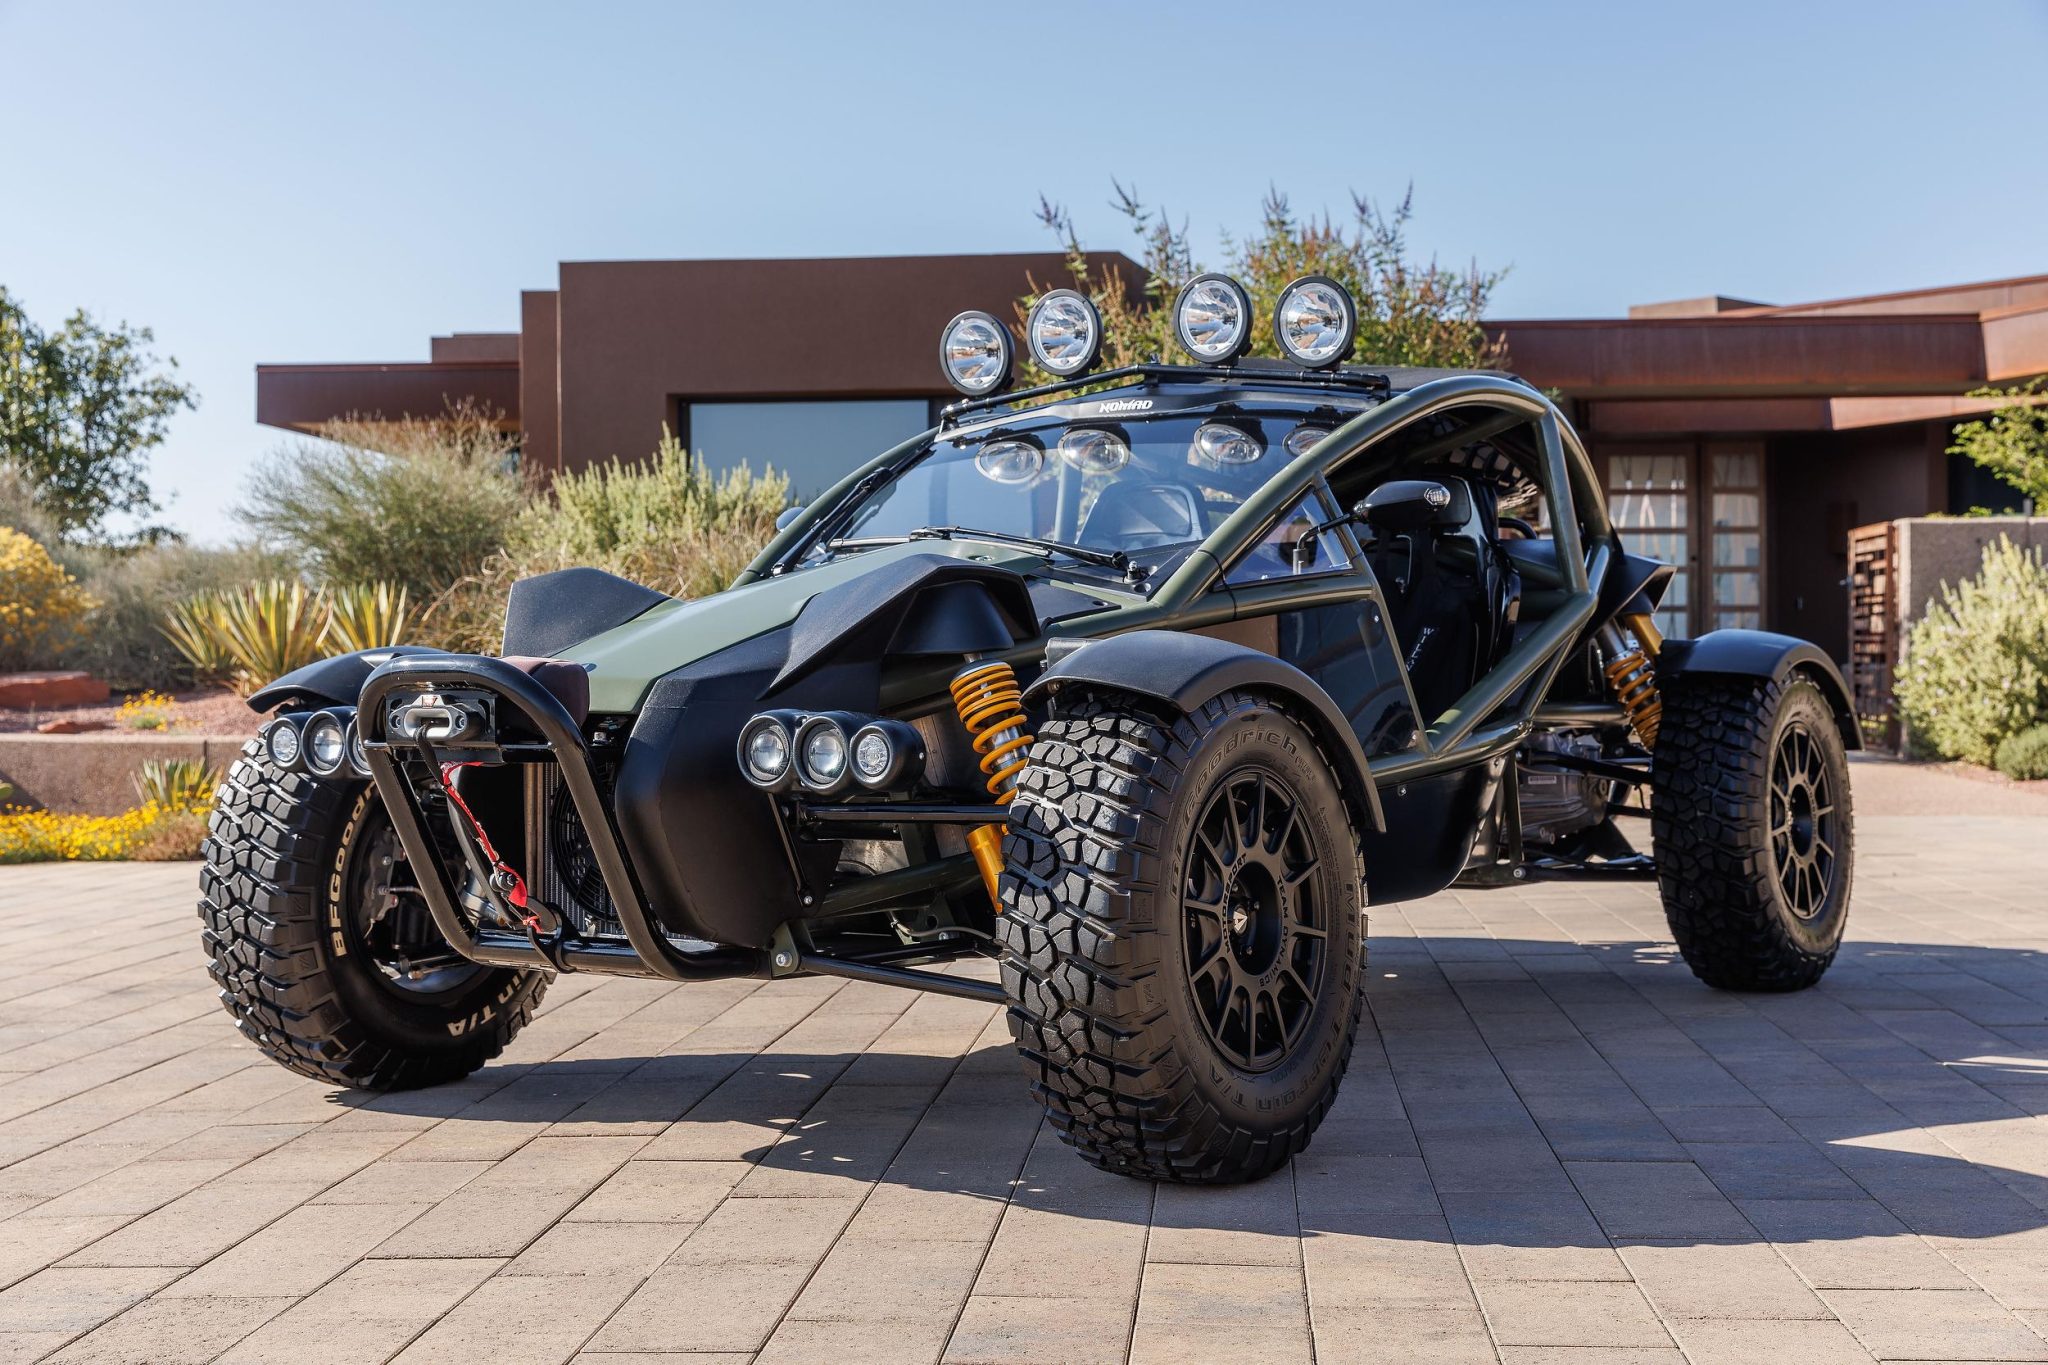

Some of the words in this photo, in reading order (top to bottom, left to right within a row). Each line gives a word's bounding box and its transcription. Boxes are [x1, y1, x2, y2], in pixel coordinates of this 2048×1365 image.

[1099, 399, 1153, 413] NOMAD
[330, 781, 376, 957] BFGoodr
[1276, 875, 1288, 919] TEAM
[1259, 925, 1288, 987] DYNAMICS
[447, 1006, 497, 1037] T/A
[1209, 1059, 1249, 1110] T/A
